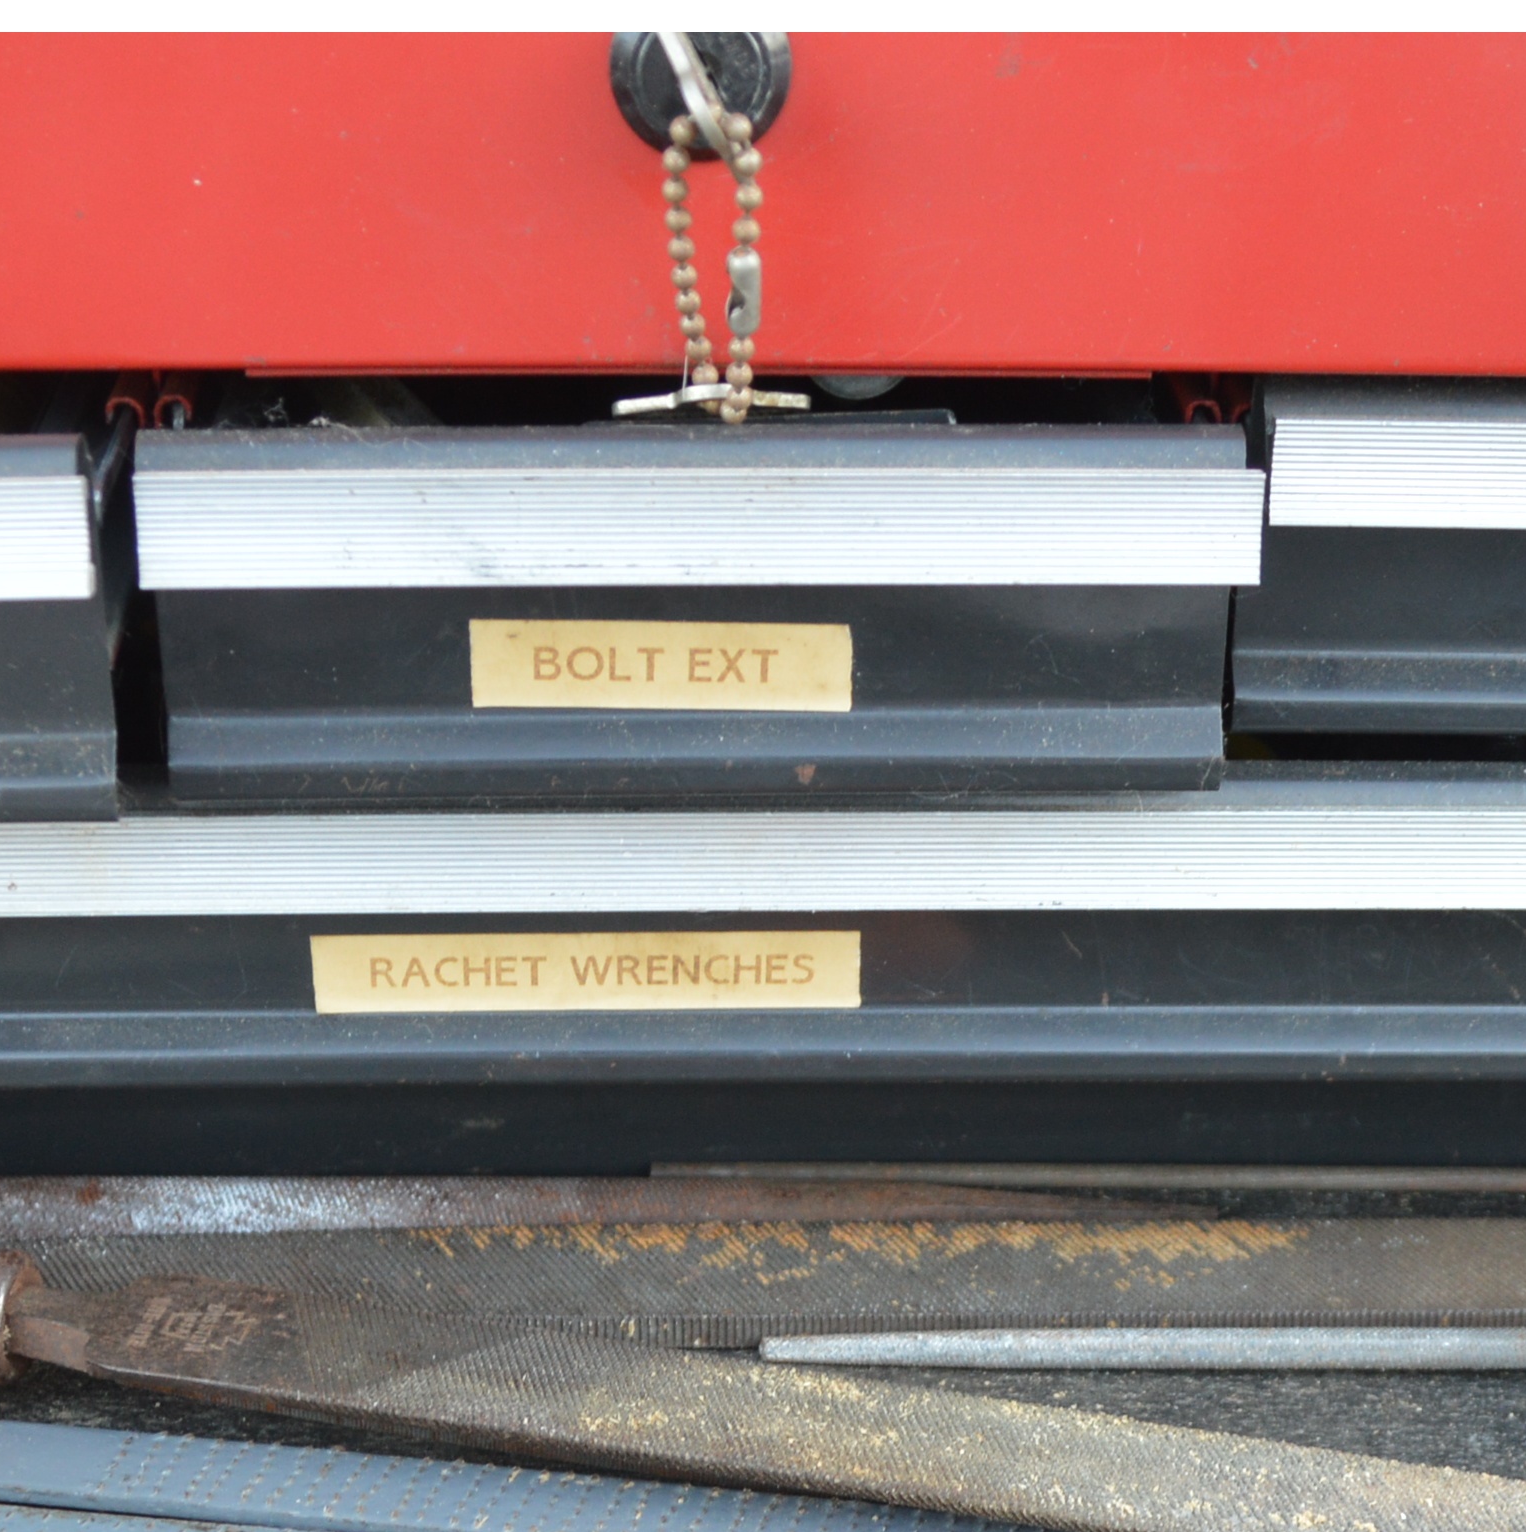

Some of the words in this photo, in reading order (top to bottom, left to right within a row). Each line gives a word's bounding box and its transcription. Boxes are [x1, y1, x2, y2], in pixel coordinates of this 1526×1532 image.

[532, 645, 665, 682] BOLT
[687, 647, 779, 684] EXT
[368, 955, 548, 990] RACHET
[569, 952, 816, 987] WRENCHES
